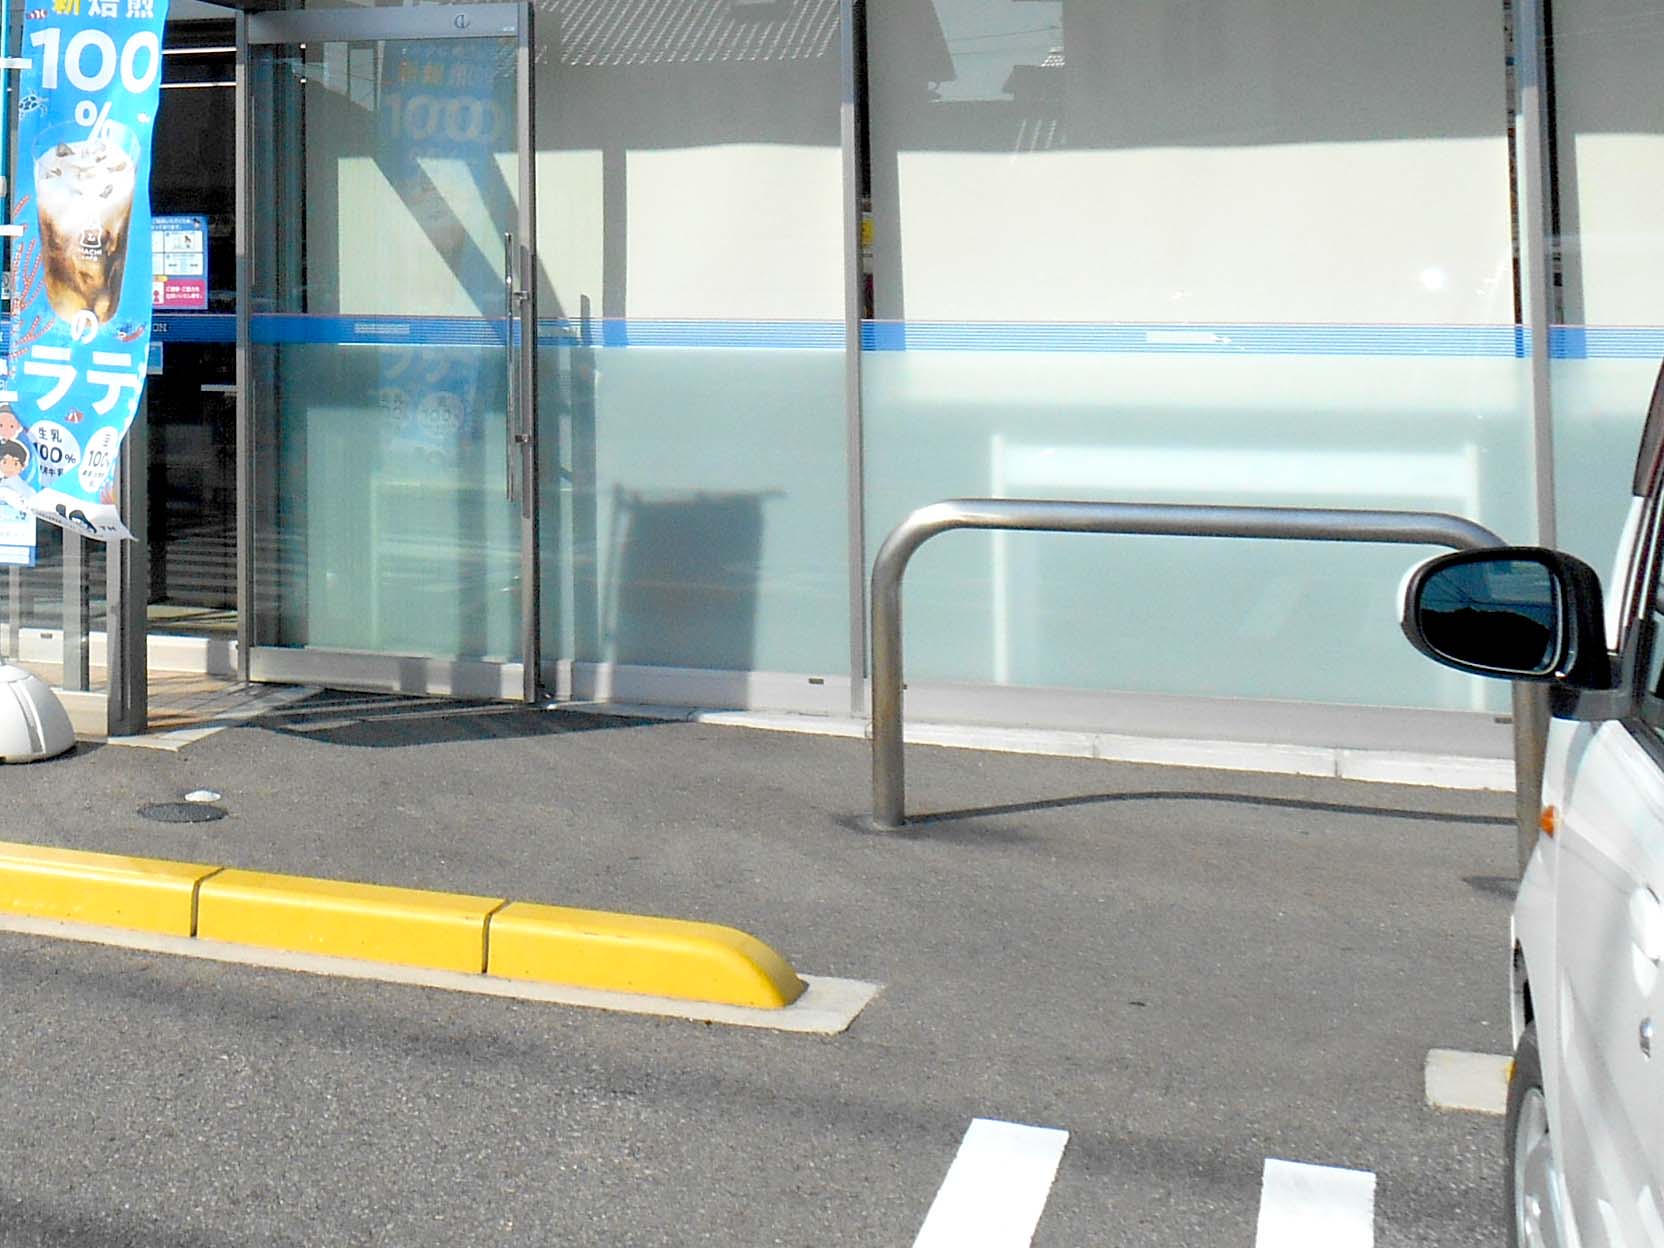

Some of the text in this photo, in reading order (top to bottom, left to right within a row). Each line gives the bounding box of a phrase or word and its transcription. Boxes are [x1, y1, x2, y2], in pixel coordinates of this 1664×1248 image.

[30, 27, 159, 94] 100
[71, 310, 98, 344] の
[23, 345, 143, 414] ラテ
[38, 427, 63, 443] 生乳
